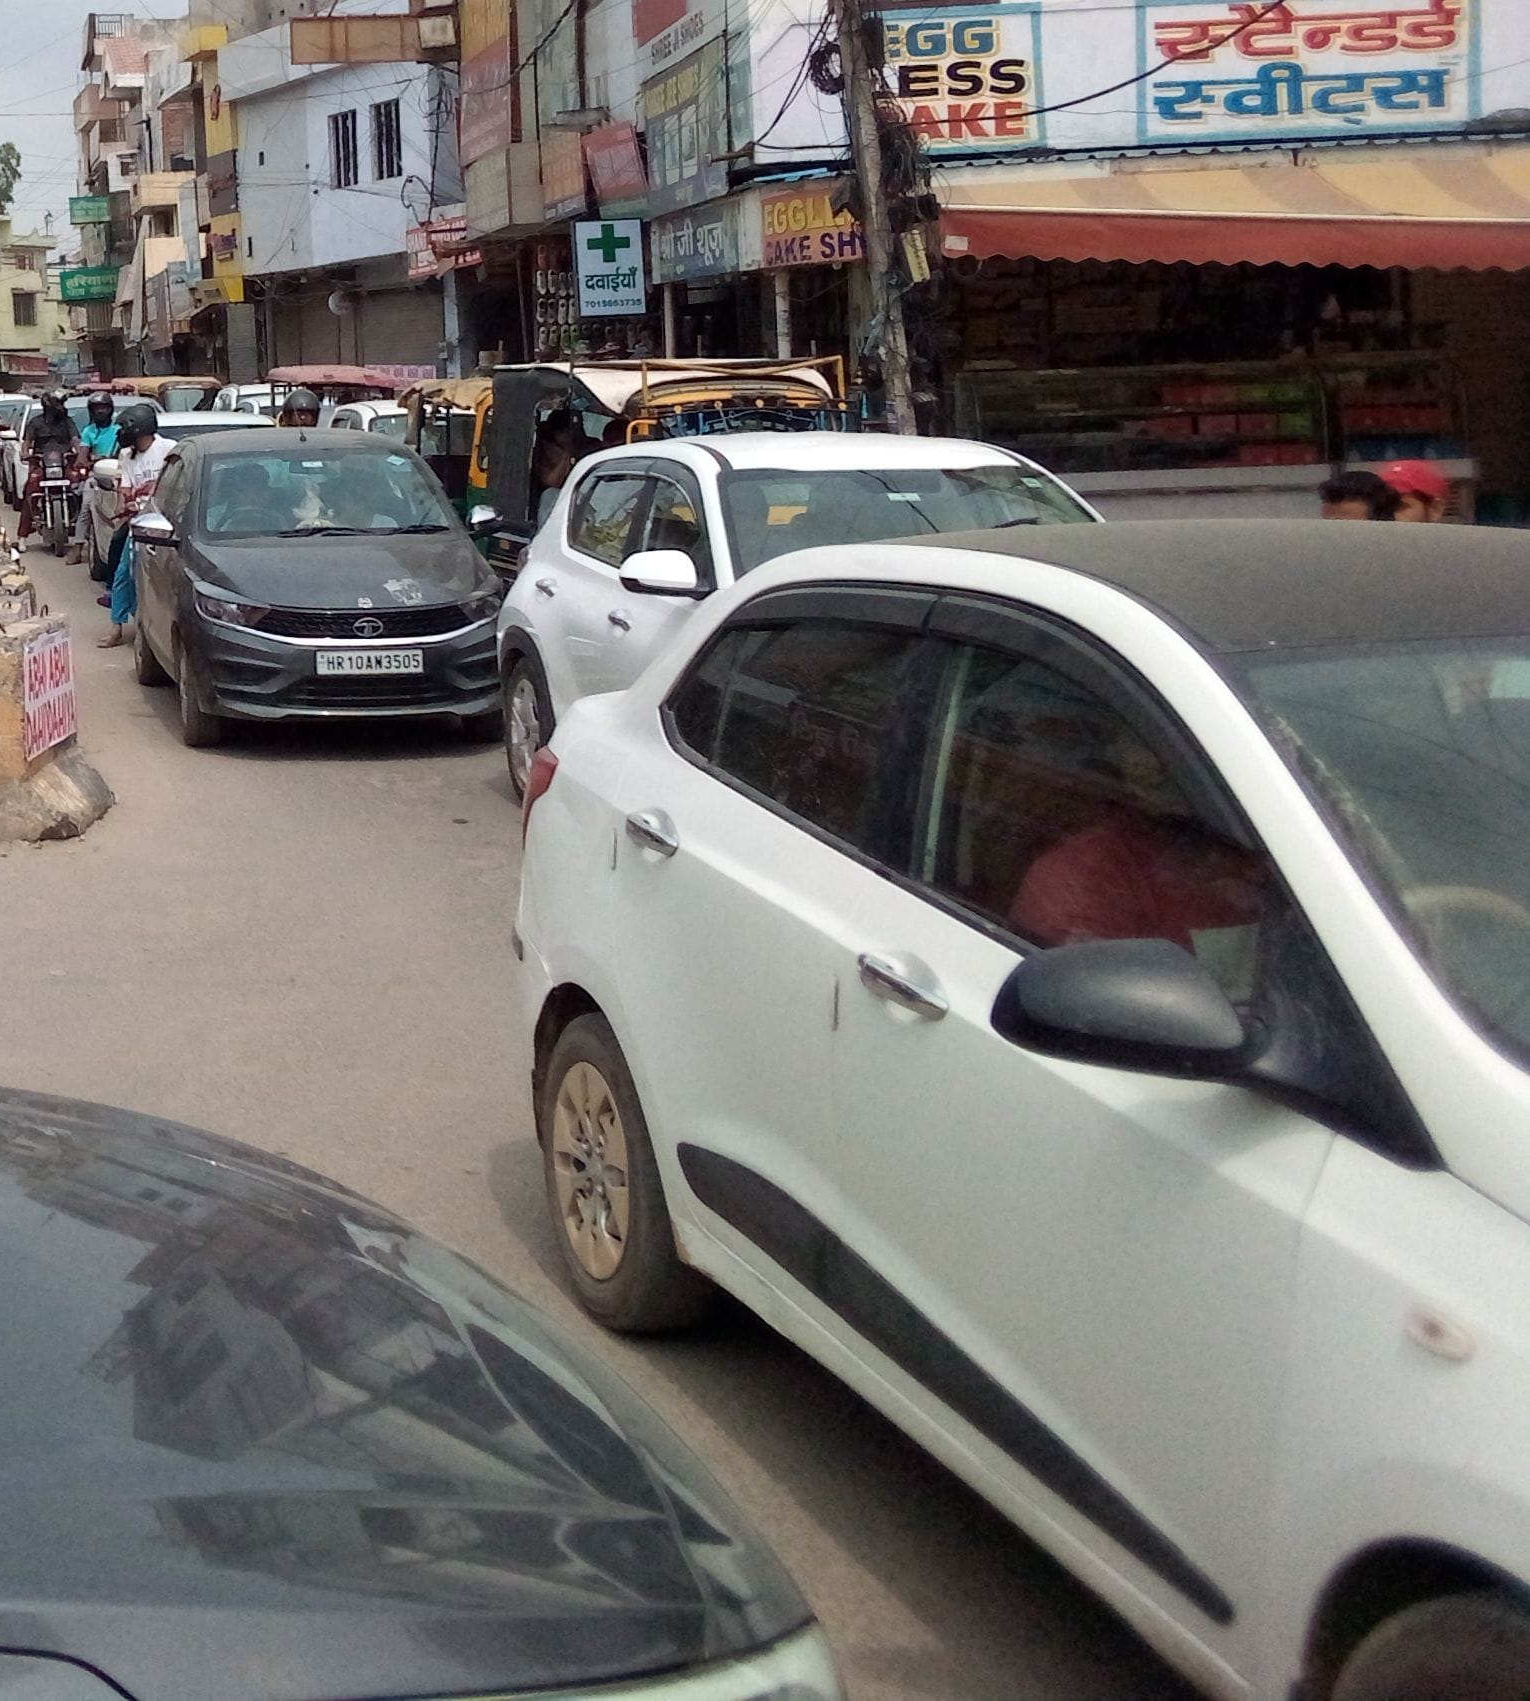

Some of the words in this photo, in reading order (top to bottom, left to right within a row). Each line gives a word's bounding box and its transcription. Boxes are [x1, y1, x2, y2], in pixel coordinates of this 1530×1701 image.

[875, 59, 1026, 98] ESS
[676, 218, 694, 256] जी
[585, 266, 638, 292] दवाईयाँ
